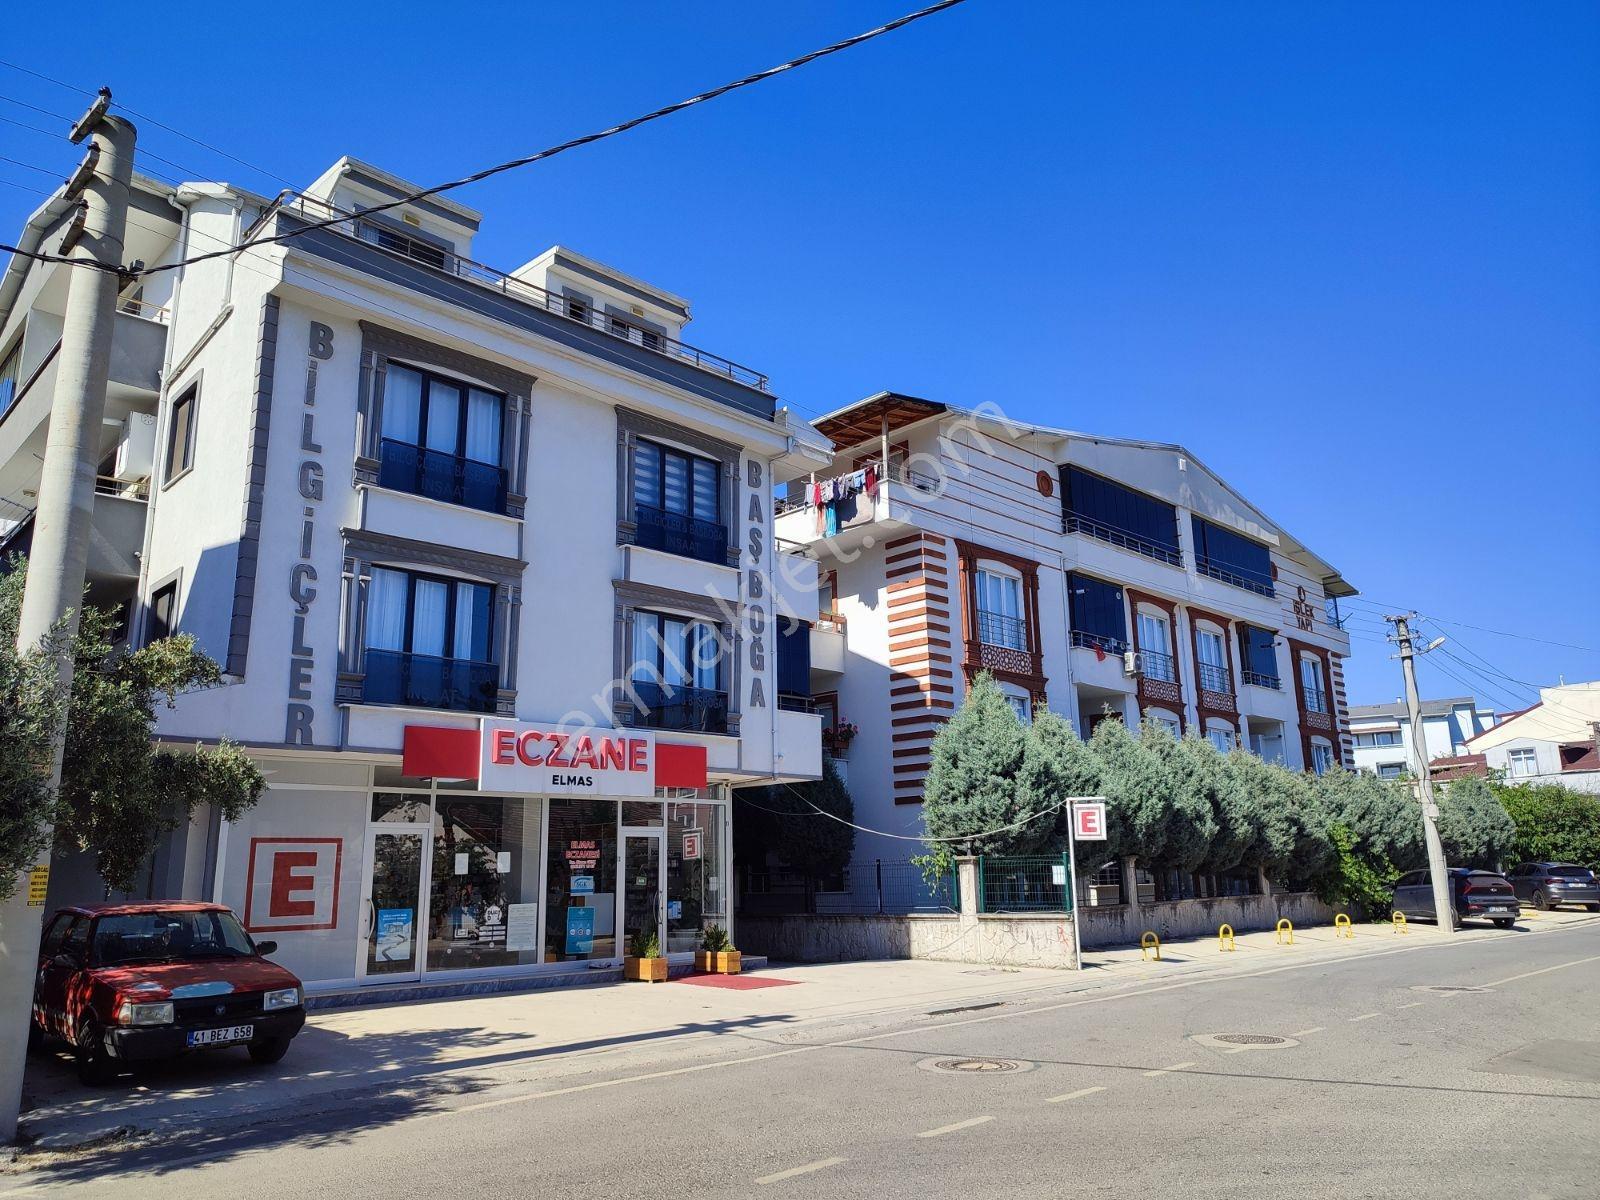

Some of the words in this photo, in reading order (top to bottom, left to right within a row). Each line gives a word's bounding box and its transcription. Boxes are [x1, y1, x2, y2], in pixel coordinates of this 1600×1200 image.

[285, 320, 334, 746] BİLGİÇLER
[747, 459, 766, 708] BAŞBOĞA
[491, 728, 649, 773] ECZANE
[552, 775, 593, 787] ELMAS
[1081, 811, 1098, 833] E
[269, 851, 318, 917] E
[194, 1031, 205, 1043] 41
[210, 1029, 229, 1041] BEZ
[233, 1026, 252, 1039] 658
